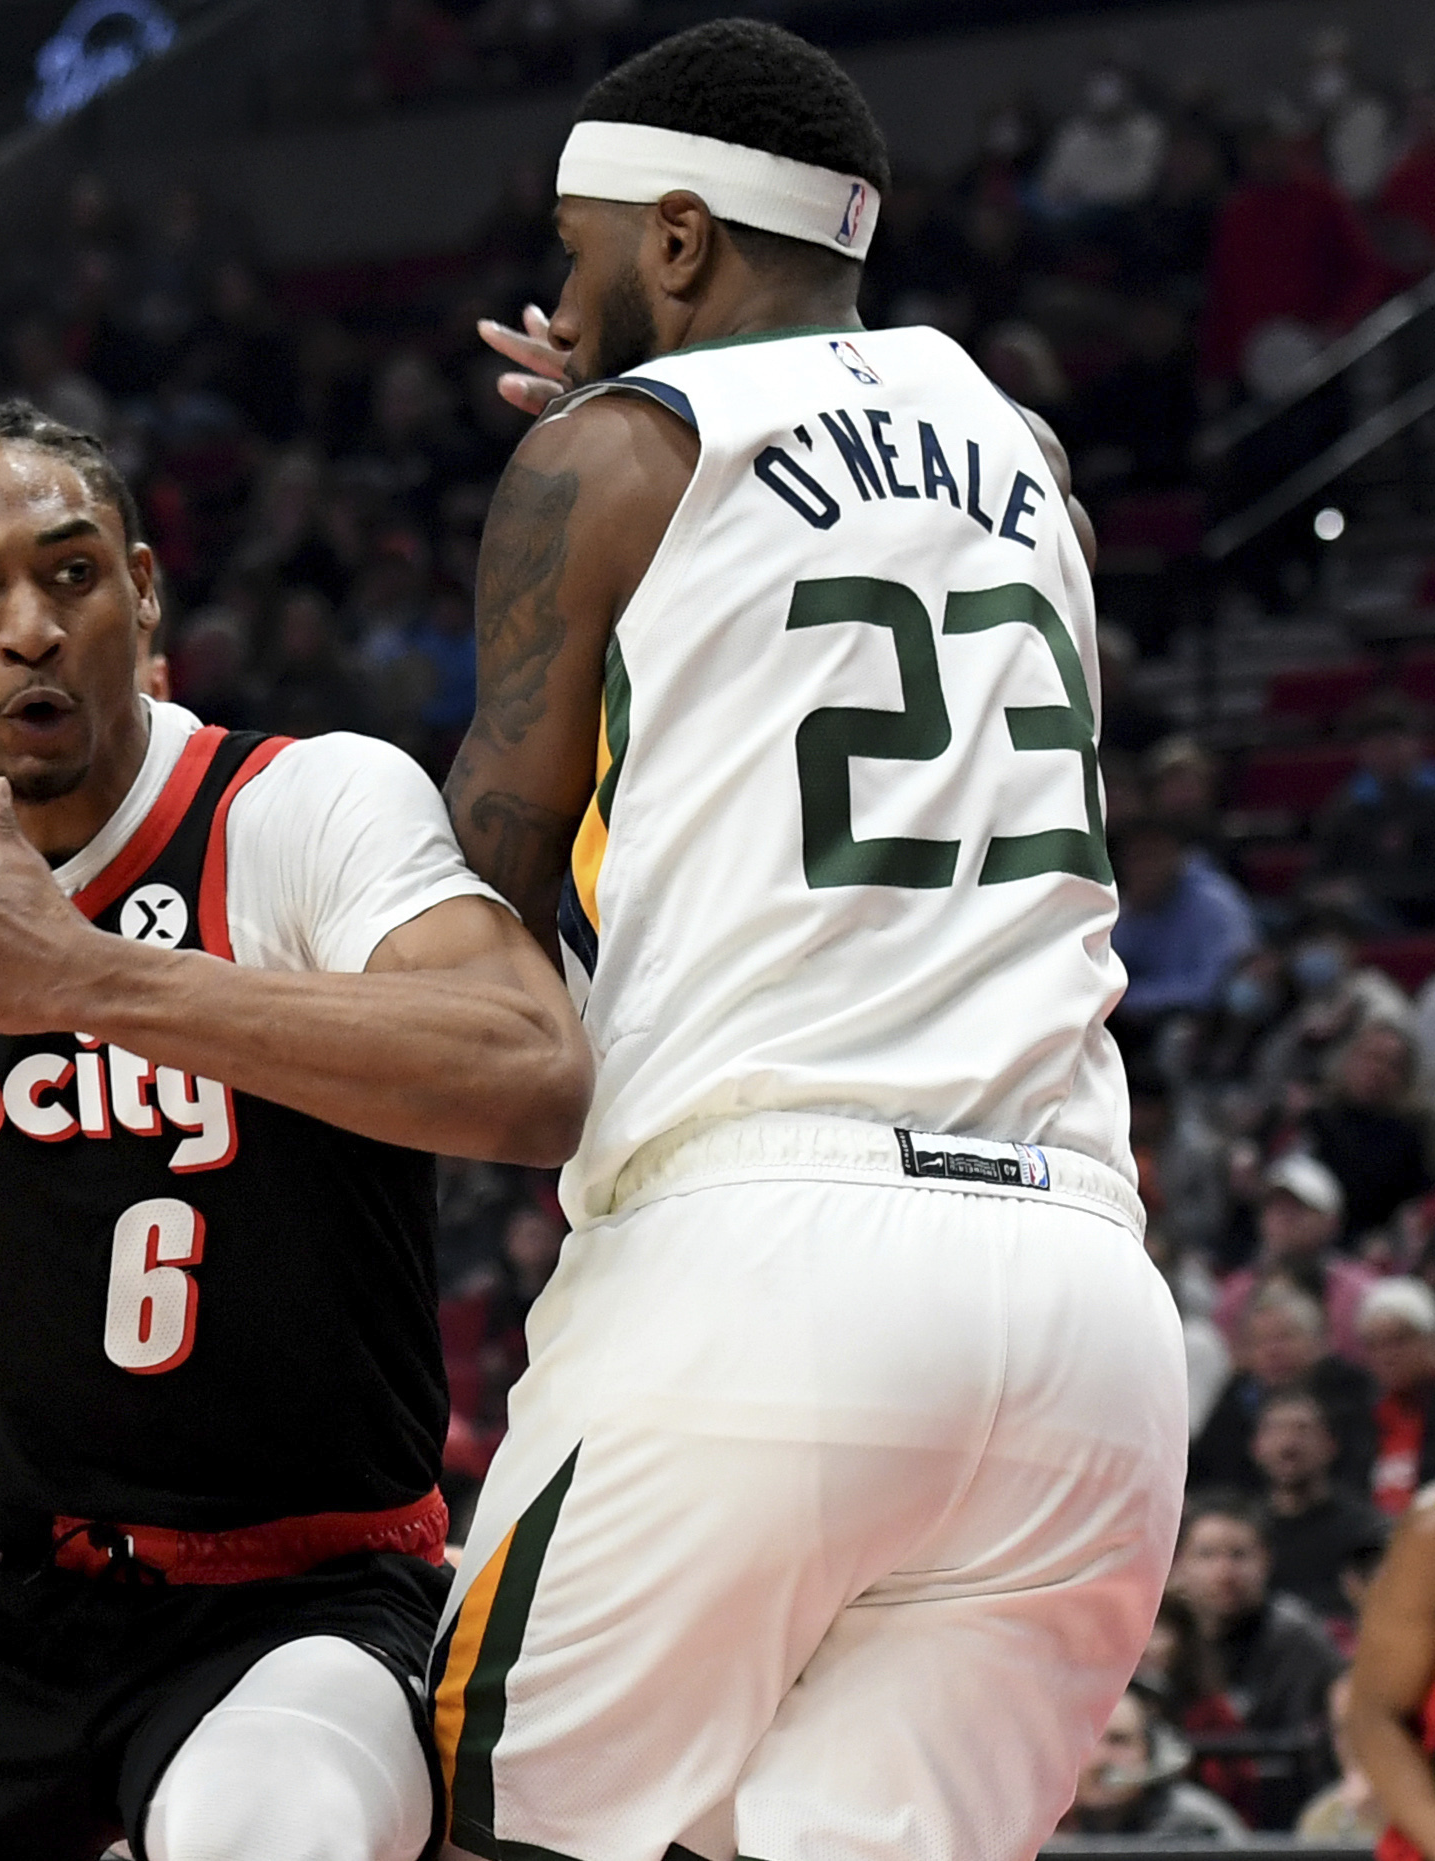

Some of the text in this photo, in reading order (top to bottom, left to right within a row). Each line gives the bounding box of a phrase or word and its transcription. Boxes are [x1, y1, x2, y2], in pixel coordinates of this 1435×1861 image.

[753, 408, 1046, 551] O'NEALE
[786, 575, 1114, 889] 23
[104, 1197, 206, 1375] 6
